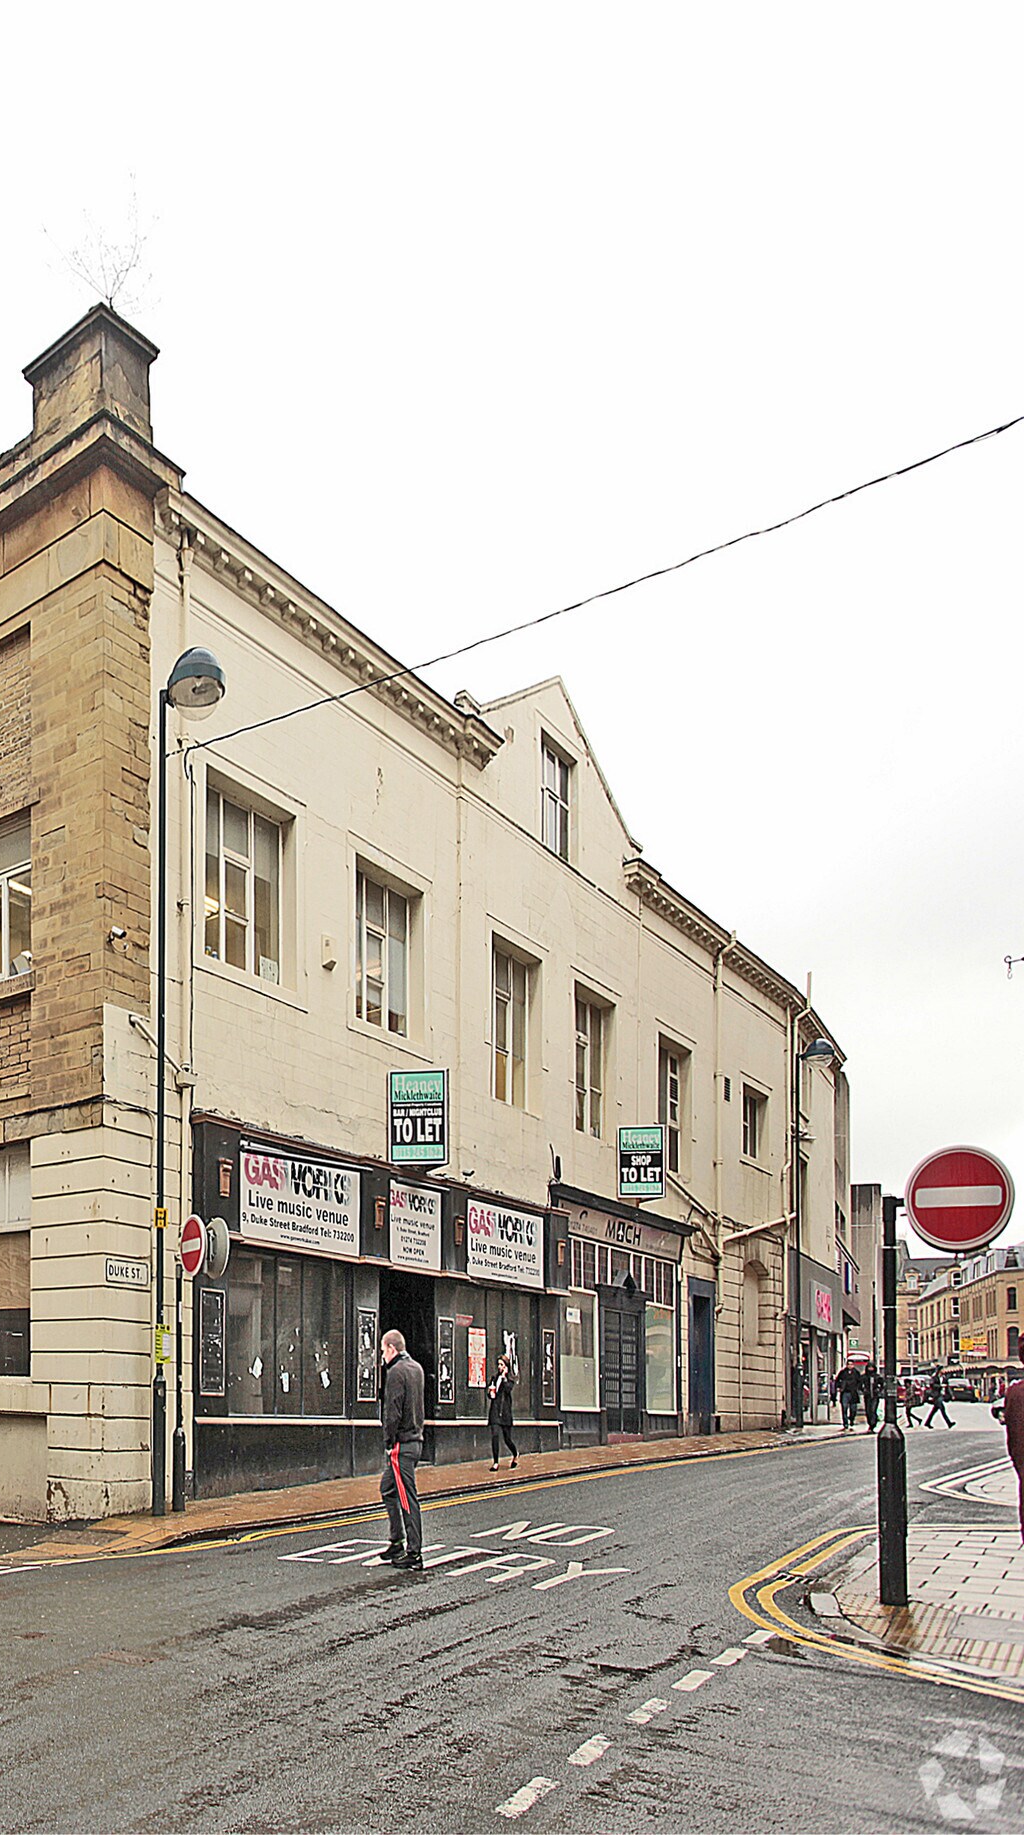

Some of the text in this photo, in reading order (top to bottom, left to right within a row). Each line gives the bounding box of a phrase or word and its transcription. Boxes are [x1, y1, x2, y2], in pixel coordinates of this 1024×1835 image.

[394, 1076, 441, 1093] Heaney
[394, 1090, 442, 1101] Micklethwaite
[393, 1109, 405, 1117] BAR
[409, 1108, 442, 1116] NIGHTCLUB
[394, 1118, 442, 1143] TO LET
[631, 1155, 651, 1166] SHOP
[621, 1167, 661, 1182] TO LET
[248, 1189, 349, 1226] Live music venue
[242, 1212, 249, 1223] 9,
[250, 1213, 268, 1226] Duke
[269, 1217, 290, 1230] Street
[291, 1221, 319, 1236] Bradford
[391, 1213, 436, 1231] Live music venue
[469, 1206, 495, 1237] GAS
[413, 1248, 425, 1256] OPEN
[470, 1237, 536, 1264] Live music venue
[108, 1264, 143, 1280] DUKE ST.
[472, 1256, 484, 1266] Duke
[484, 1259, 498, 1268] Street
[499, 1262, 517, 1272] Bradford
[469, 1521, 615, 1546] NO
[277, 1538, 631, 1590] ENTRY
